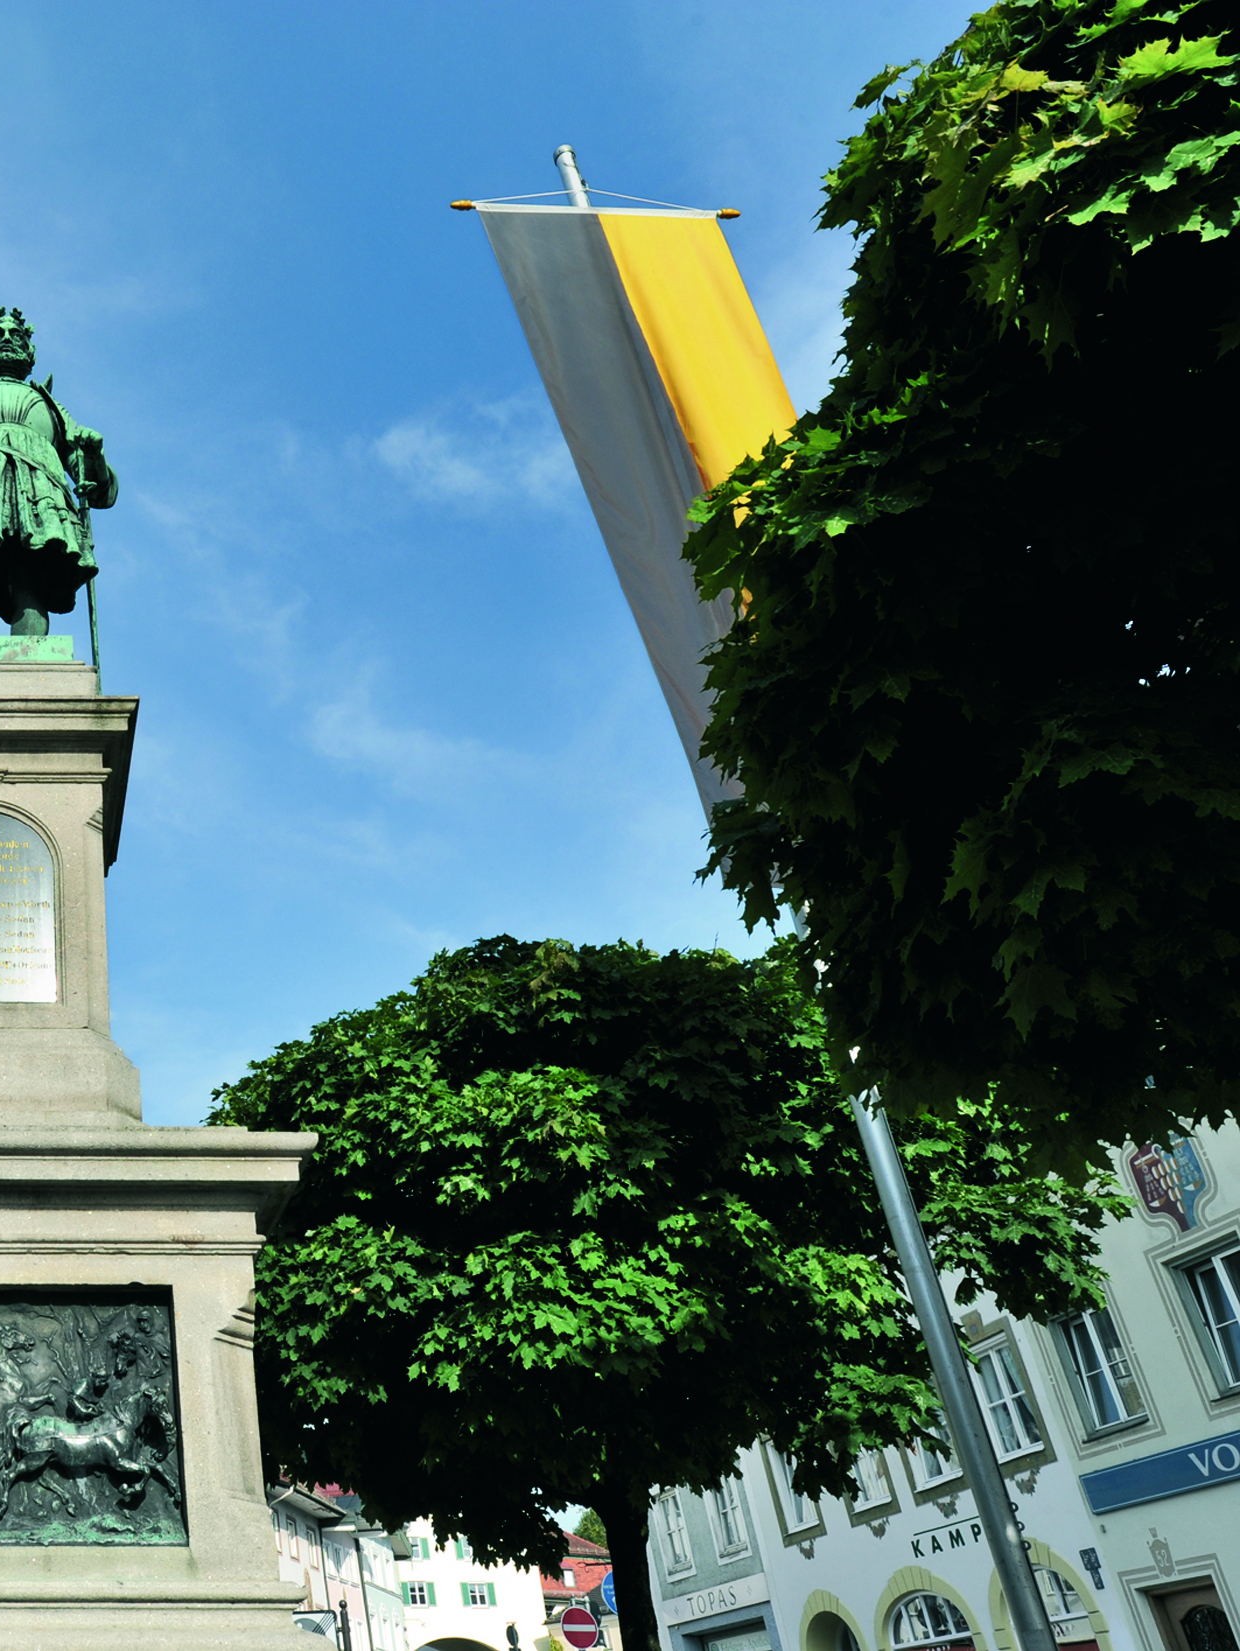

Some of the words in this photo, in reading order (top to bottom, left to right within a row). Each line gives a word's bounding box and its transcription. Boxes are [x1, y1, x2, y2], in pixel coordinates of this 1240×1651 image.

[1187, 1443, 1240, 1477] VO
[911, 1523, 982, 1558] KAMP
[1155, 1549, 1170, 1567] 52
[686, 1585, 737, 1616] TOPAS
